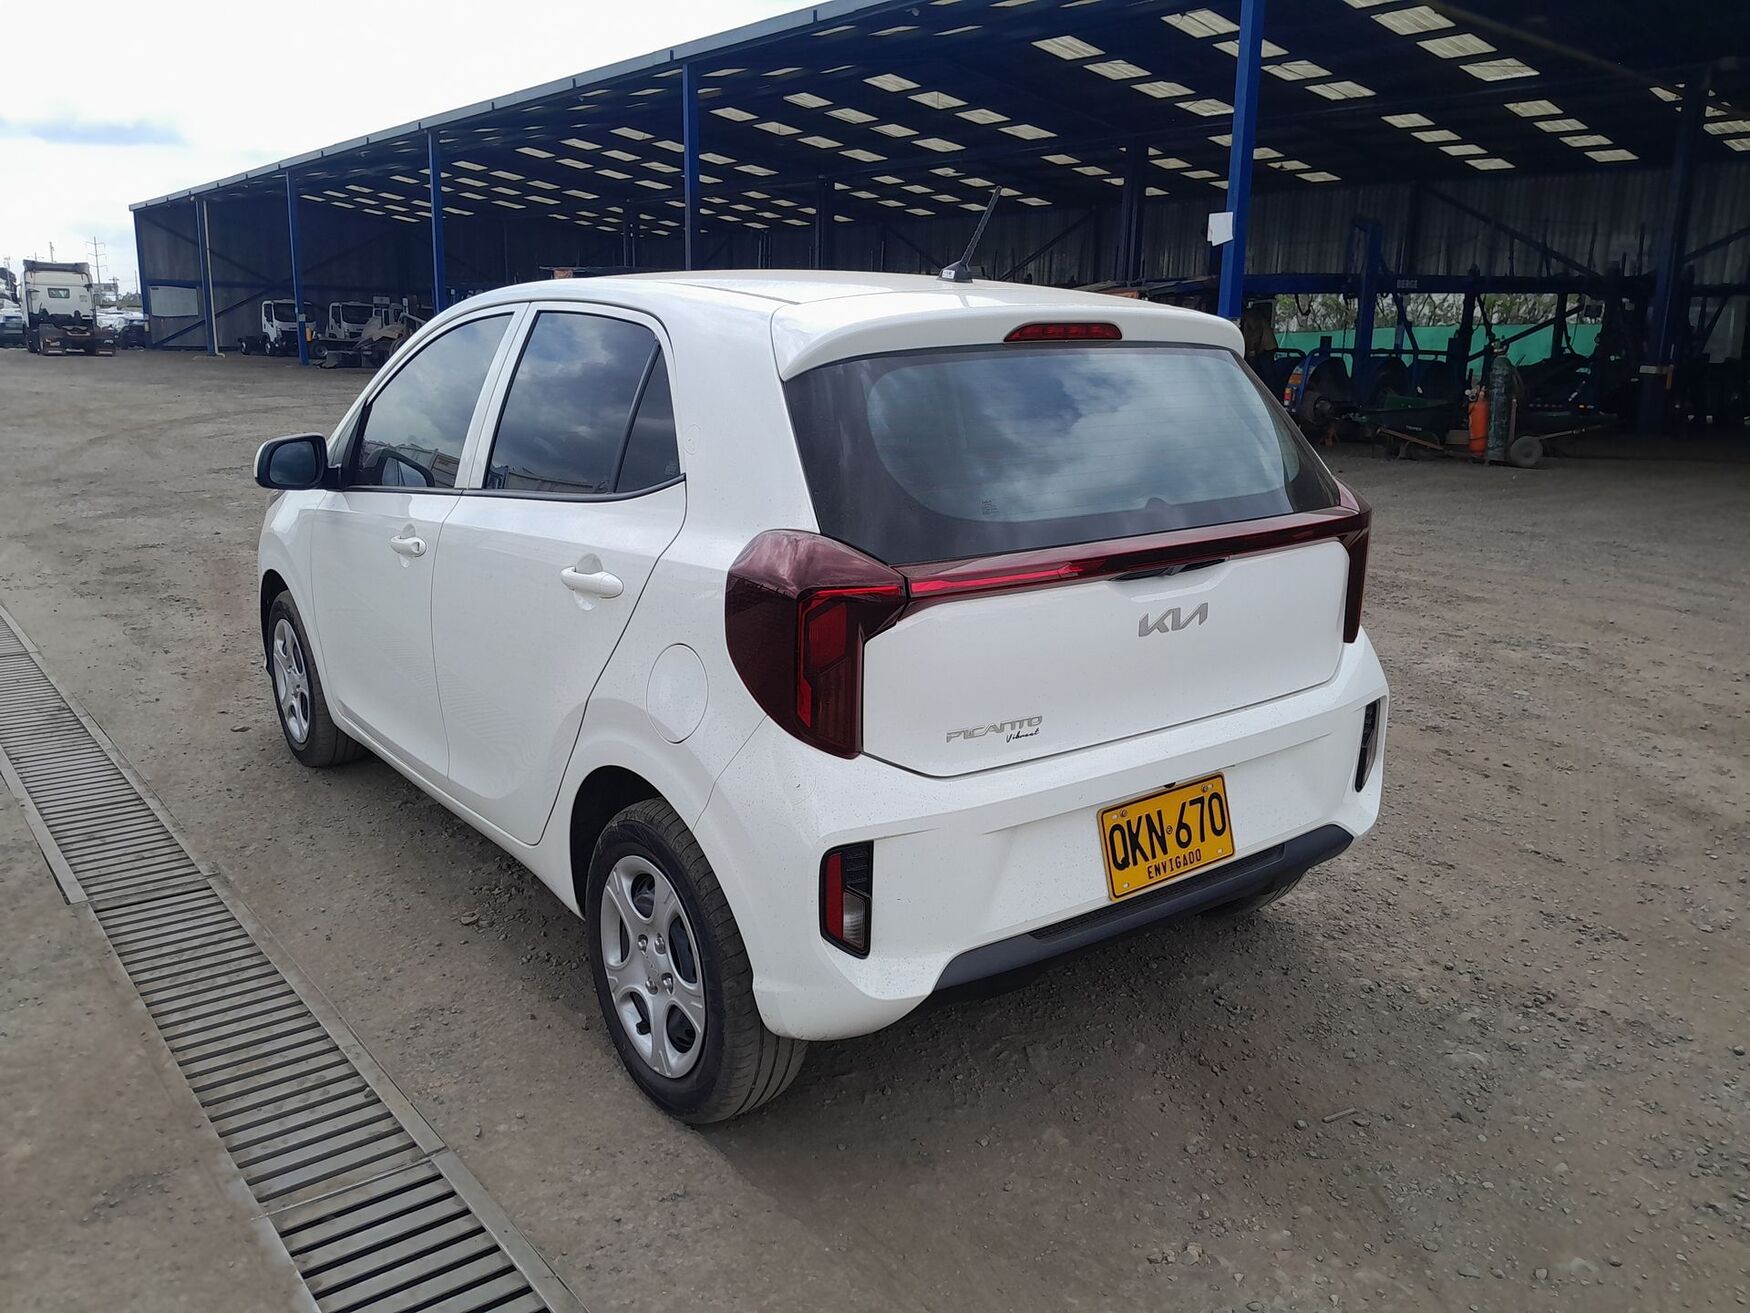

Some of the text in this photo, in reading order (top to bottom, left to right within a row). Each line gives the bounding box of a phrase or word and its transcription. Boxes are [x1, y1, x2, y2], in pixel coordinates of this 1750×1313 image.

[946, 715, 1043, 743] PICANTO
[1108, 792, 1227, 871] QKN 670
[1147, 848, 1202, 879] ENVIGADO
